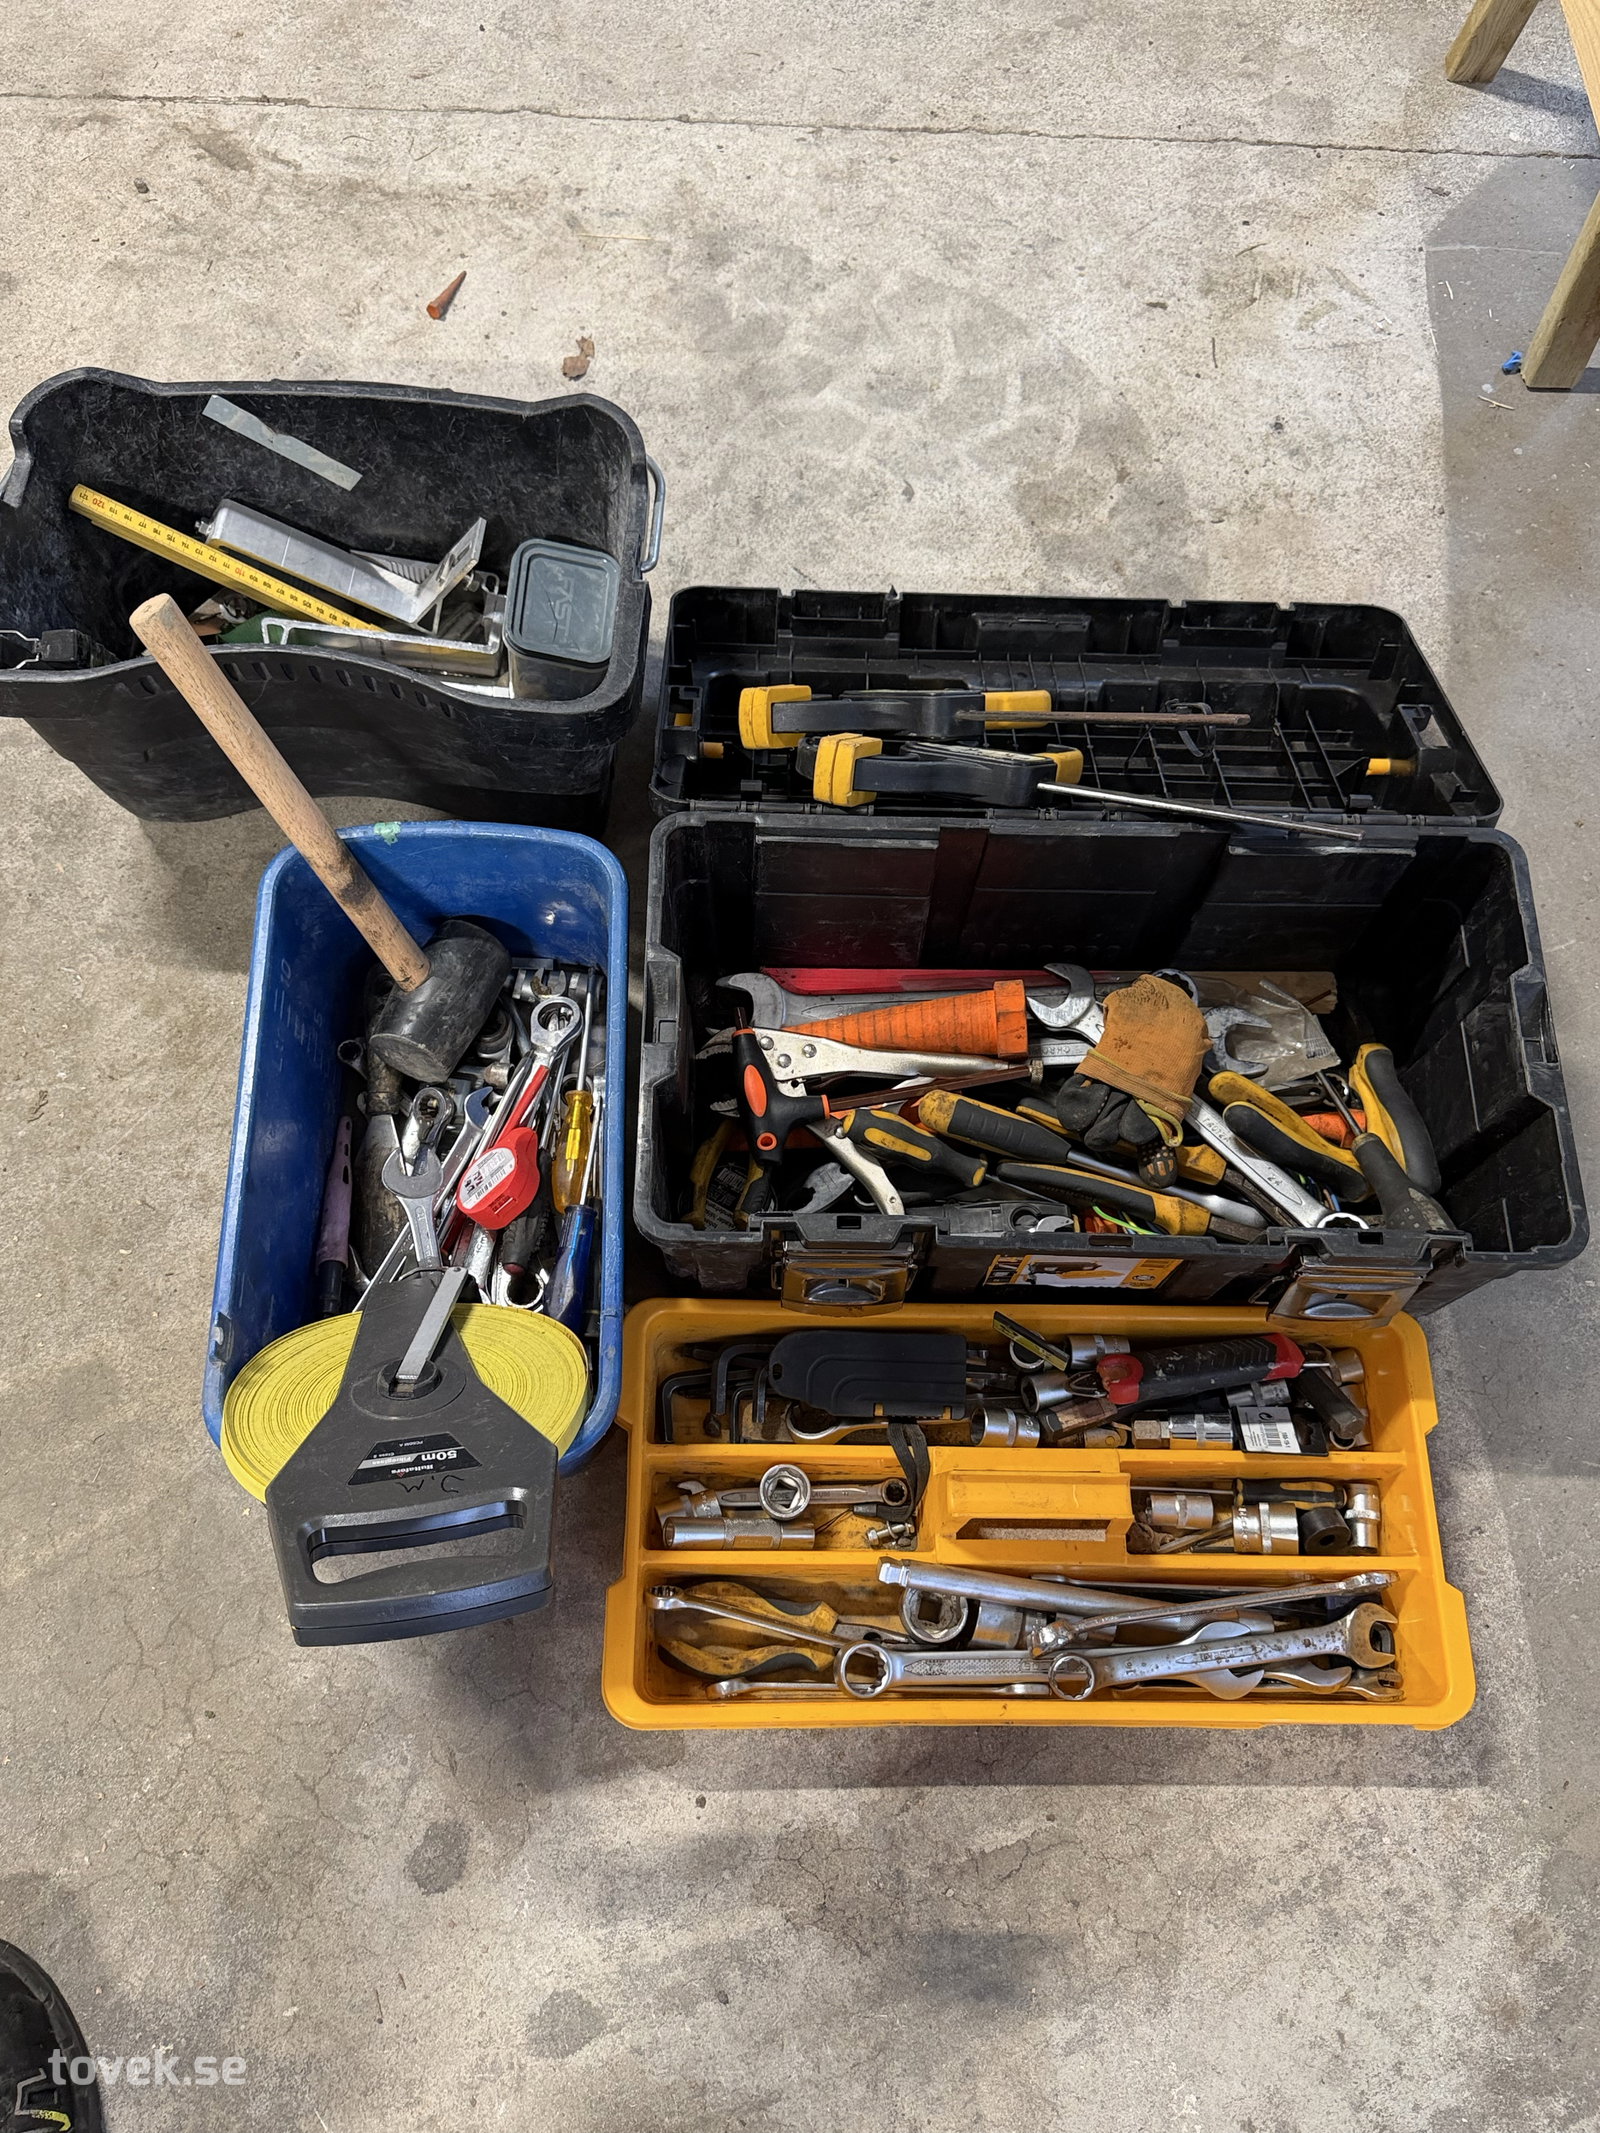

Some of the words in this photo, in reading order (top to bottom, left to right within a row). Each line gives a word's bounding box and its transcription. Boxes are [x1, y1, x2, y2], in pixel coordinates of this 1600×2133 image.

[93, 498, 105, 508] 120
[167, 534, 175, 542] 115
[181, 541, 189, 549] 114
[195, 548, 203, 556] 113
[209, 554, 217, 563] 112
[234, 567, 245, 577] 110
[303, 600, 312, 608] 105
[421, 1450, 457, 1461] 50m
[391, 1464, 433, 1474] Hultafors
